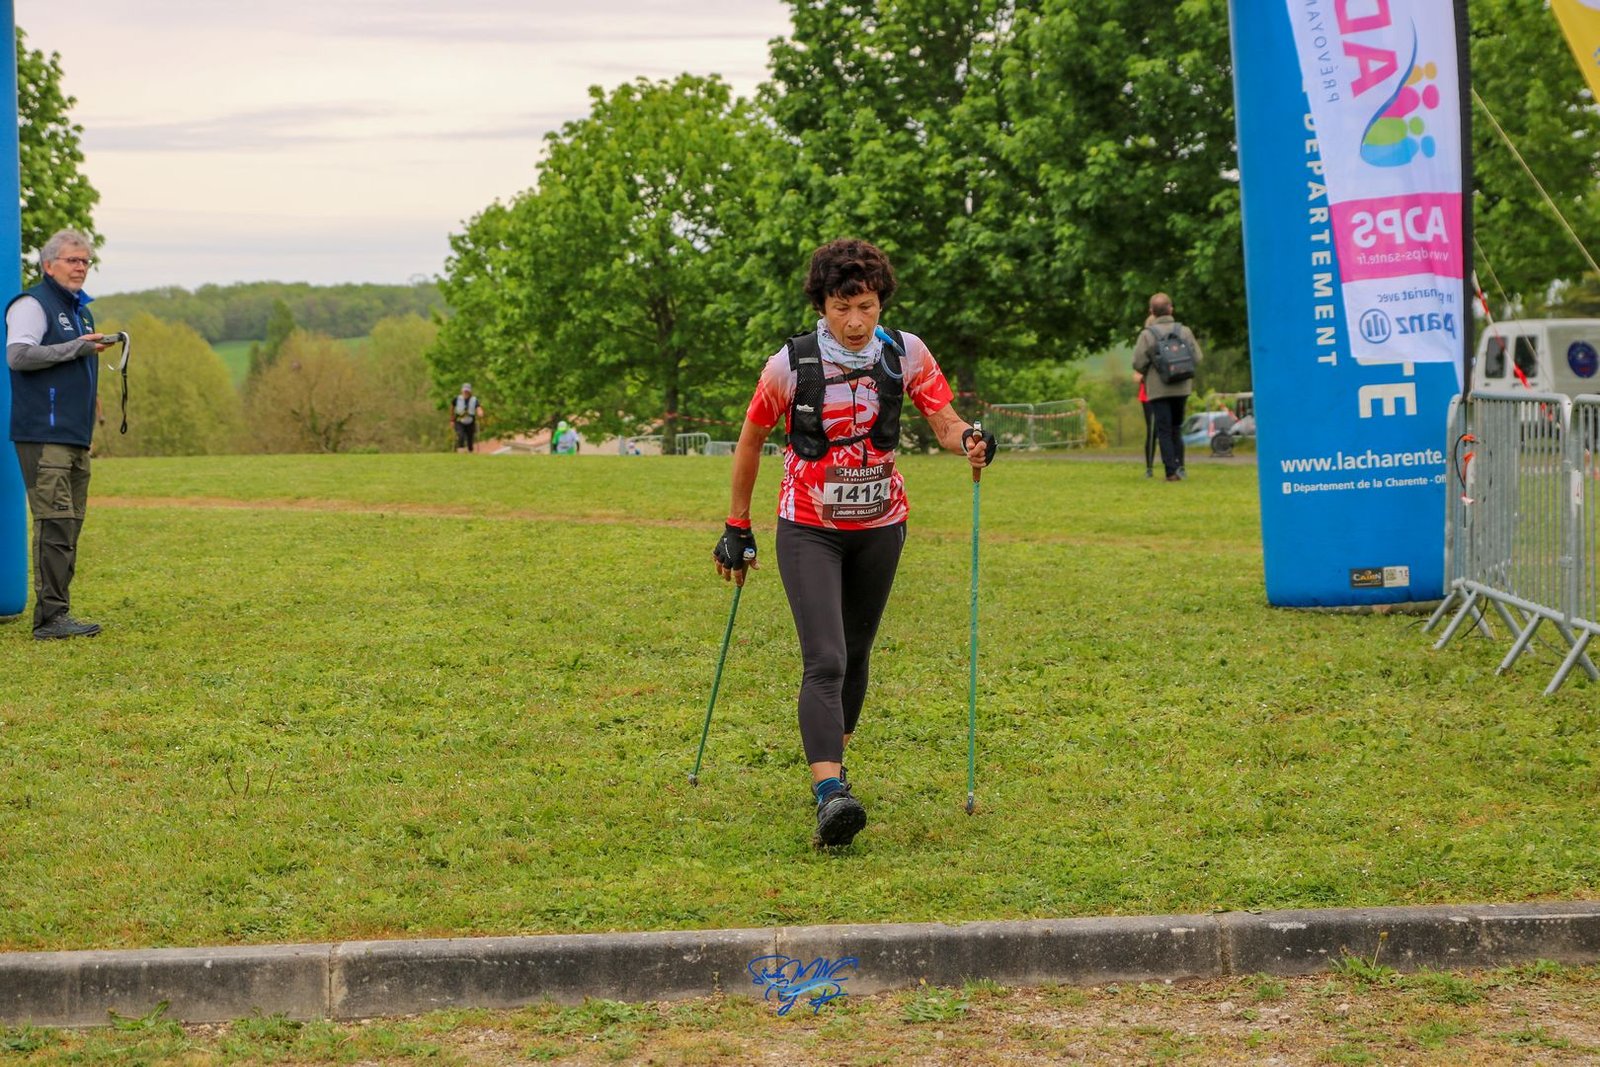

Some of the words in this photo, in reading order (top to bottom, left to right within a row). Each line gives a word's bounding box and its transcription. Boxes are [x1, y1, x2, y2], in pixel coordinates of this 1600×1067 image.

[833, 483, 883, 503] 1412
[1293, 479, 1355, 494] Département
[1357, 480, 1370, 489] de
[1373, 478, 1383, 488] la
[1385, 475, 1428, 488] Charente
